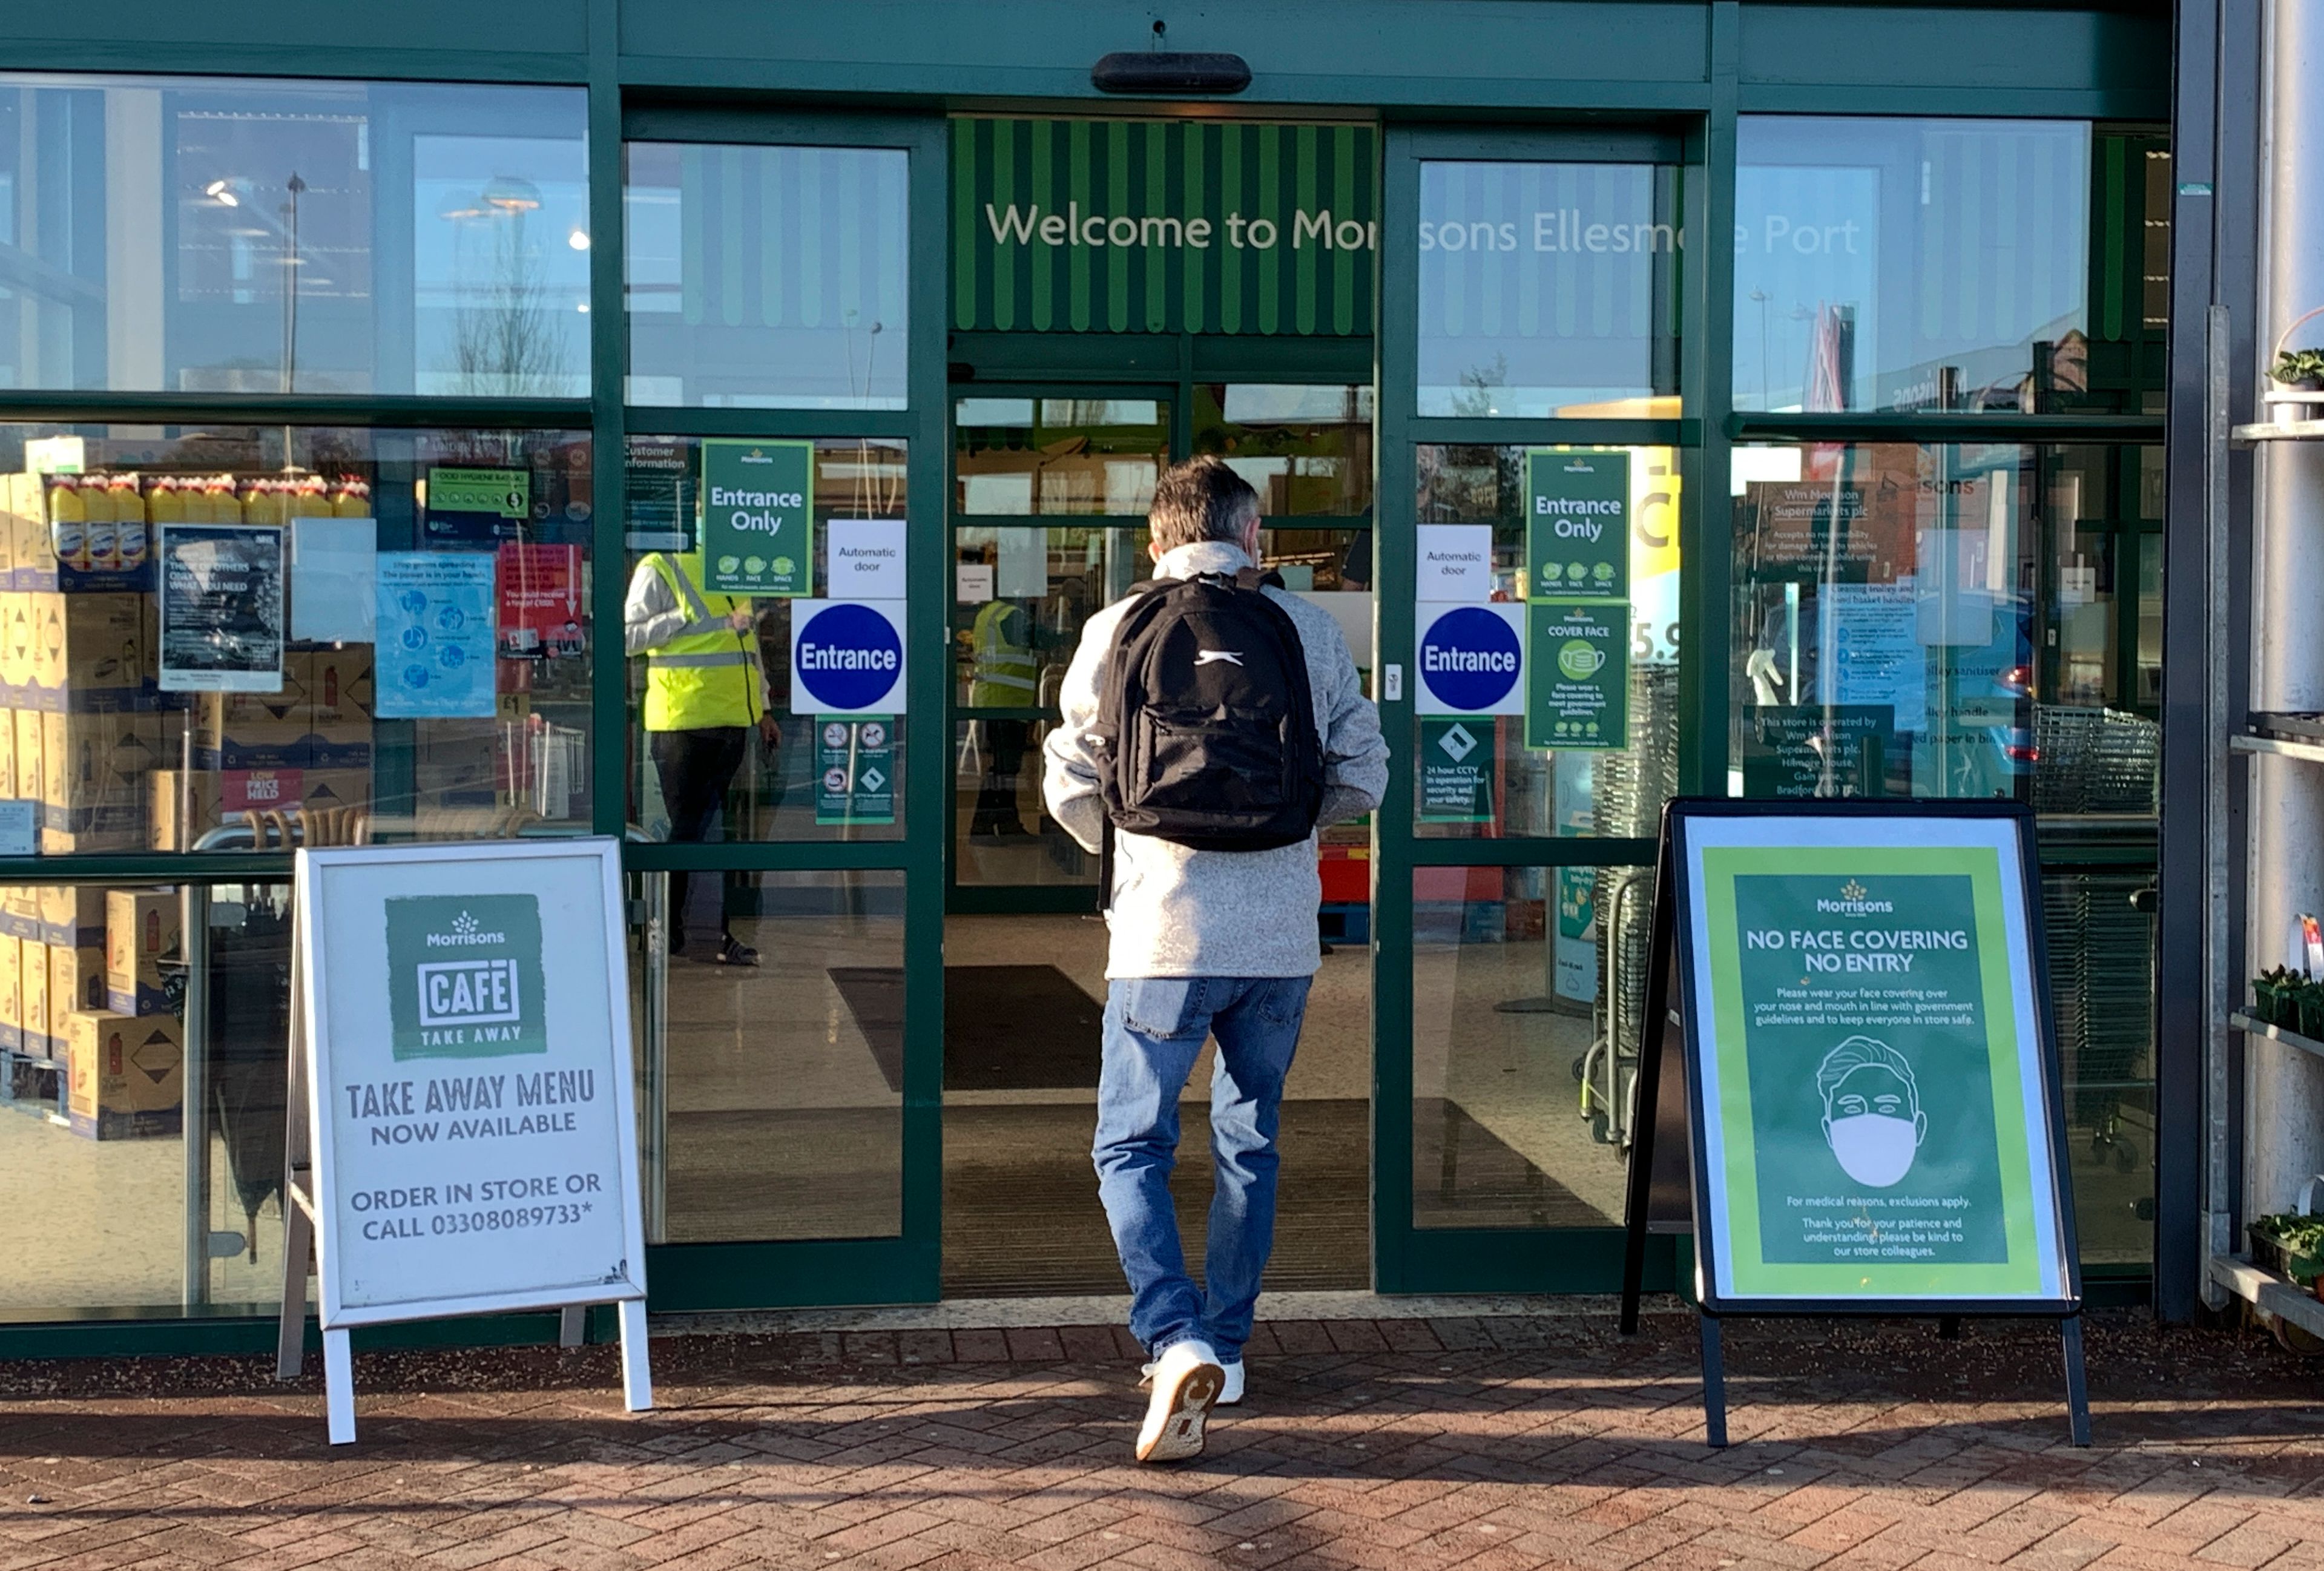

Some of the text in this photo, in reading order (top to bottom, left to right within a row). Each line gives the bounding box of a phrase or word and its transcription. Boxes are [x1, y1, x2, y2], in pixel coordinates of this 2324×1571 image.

[986, 200, 1211, 248] Welcome
[1226, 212, 1277, 249] to
[1766, 216, 1858, 254] Port
[711, 487, 803, 508] Entrance
[1785, 489, 1808, 500] Wm
[1536, 496, 1622, 515] Entrance
[1852, 505, 1869, 519] plc
[731, 510, 782, 536] Only
[1554, 517, 1603, 543] Only
[838, 547, 896, 558] Automatic
[1426, 551, 1481, 562] Automatic
[854, 562, 880, 572] door
[1441, 565, 1466, 576] door
[1548, 626, 1610, 637] COVER FACE
[801, 643, 897, 670] Entrance
[1425, 645, 1516, 672] Entrance
[1864, 716, 1877, 729] by
[1457, 766, 1478, 774] CCTV
[247, 780, 278, 789] PRICE
[247, 789, 278, 799] HELD
[1817, 898, 1893, 913] Morrisons
[426, 931, 505, 947] Morrisons
[1747, 930, 1968, 950] NO FACE COVERING
[1805, 953, 1914, 972] NO ENTRY
[1777, 987, 1807, 998] Please
[1835, 990, 1857, 1001] your
[1860, 987, 1880, 998] face
[1883, 988, 1923, 1001] covering
[1754, 1004, 1776, 1014] your
[1804, 1001, 1823, 1011] and
[1825, 1001, 1857, 1011] mouth
[1858, 1001, 1869, 1011] in
[1871, 1000, 1888, 1011] line
[1891, 1001, 1913, 1011] with
[1915, 1002, 1973, 1015] government
[1755, 1013, 1975, 1027] guidelines and to keep everyone in store safe.
[421, 1026, 521, 1046] TAKE AWAY
[346, 1069, 594, 1119] TAKE AWAY MENU
[371, 1112, 576, 1145] NOW AVAILABLE
[351, 1173, 601, 1212] ORDER IN STORE OR
[1787, 1196, 1972, 1208] For medical reasons, exclusions apply.
[363, 1217, 424, 1241] CALL
[1803, 1217, 1962, 1232] Thank you for your patience and
[1879, 1232, 1963, 1245] please be kind to
[1854, 1246, 1879, 1256] store
[1881, 1245, 1935, 1259] colleagues.
